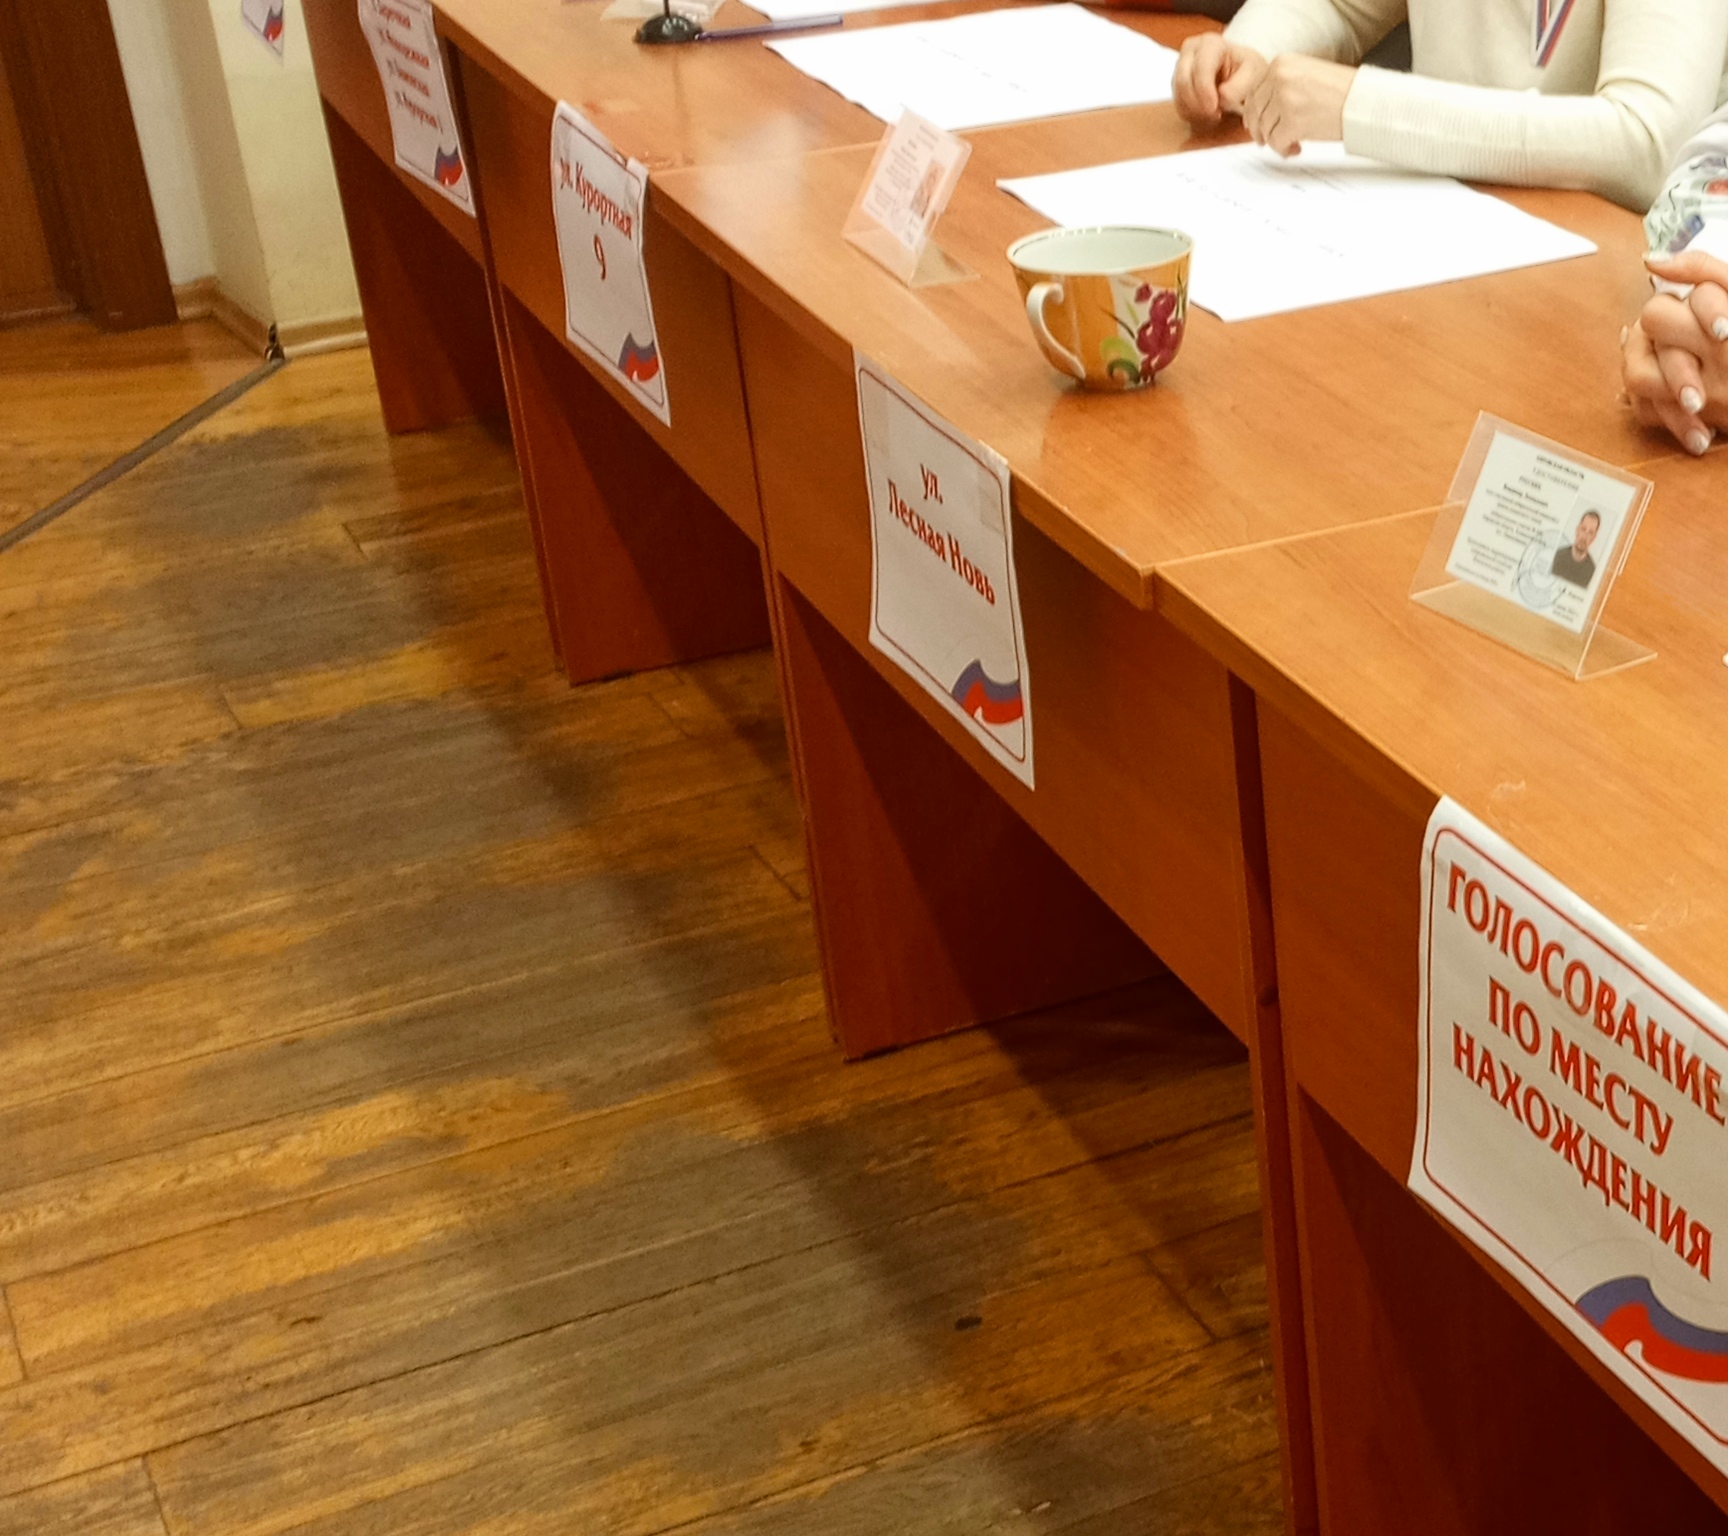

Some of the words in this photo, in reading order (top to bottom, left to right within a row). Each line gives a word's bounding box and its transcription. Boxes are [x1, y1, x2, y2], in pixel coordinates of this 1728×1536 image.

[560, 157, 574, 190] ул.
[575, 161, 633, 241] Курортная
[594, 233, 607, 282] 9
[888, 478, 947, 562] Лесная
[947, 531, 996, 606] Новь
[920, 463, 944, 505] ул.
[1447, 860, 1726, 1126] ГОЛОСОВАНИЕ
[1488, 975, 1541, 1057] ПО
[1548, 1026, 1675, 1156] МЕСТУ
[1452, 1021, 1713, 1283] НАХОЖДЕНИЯ
